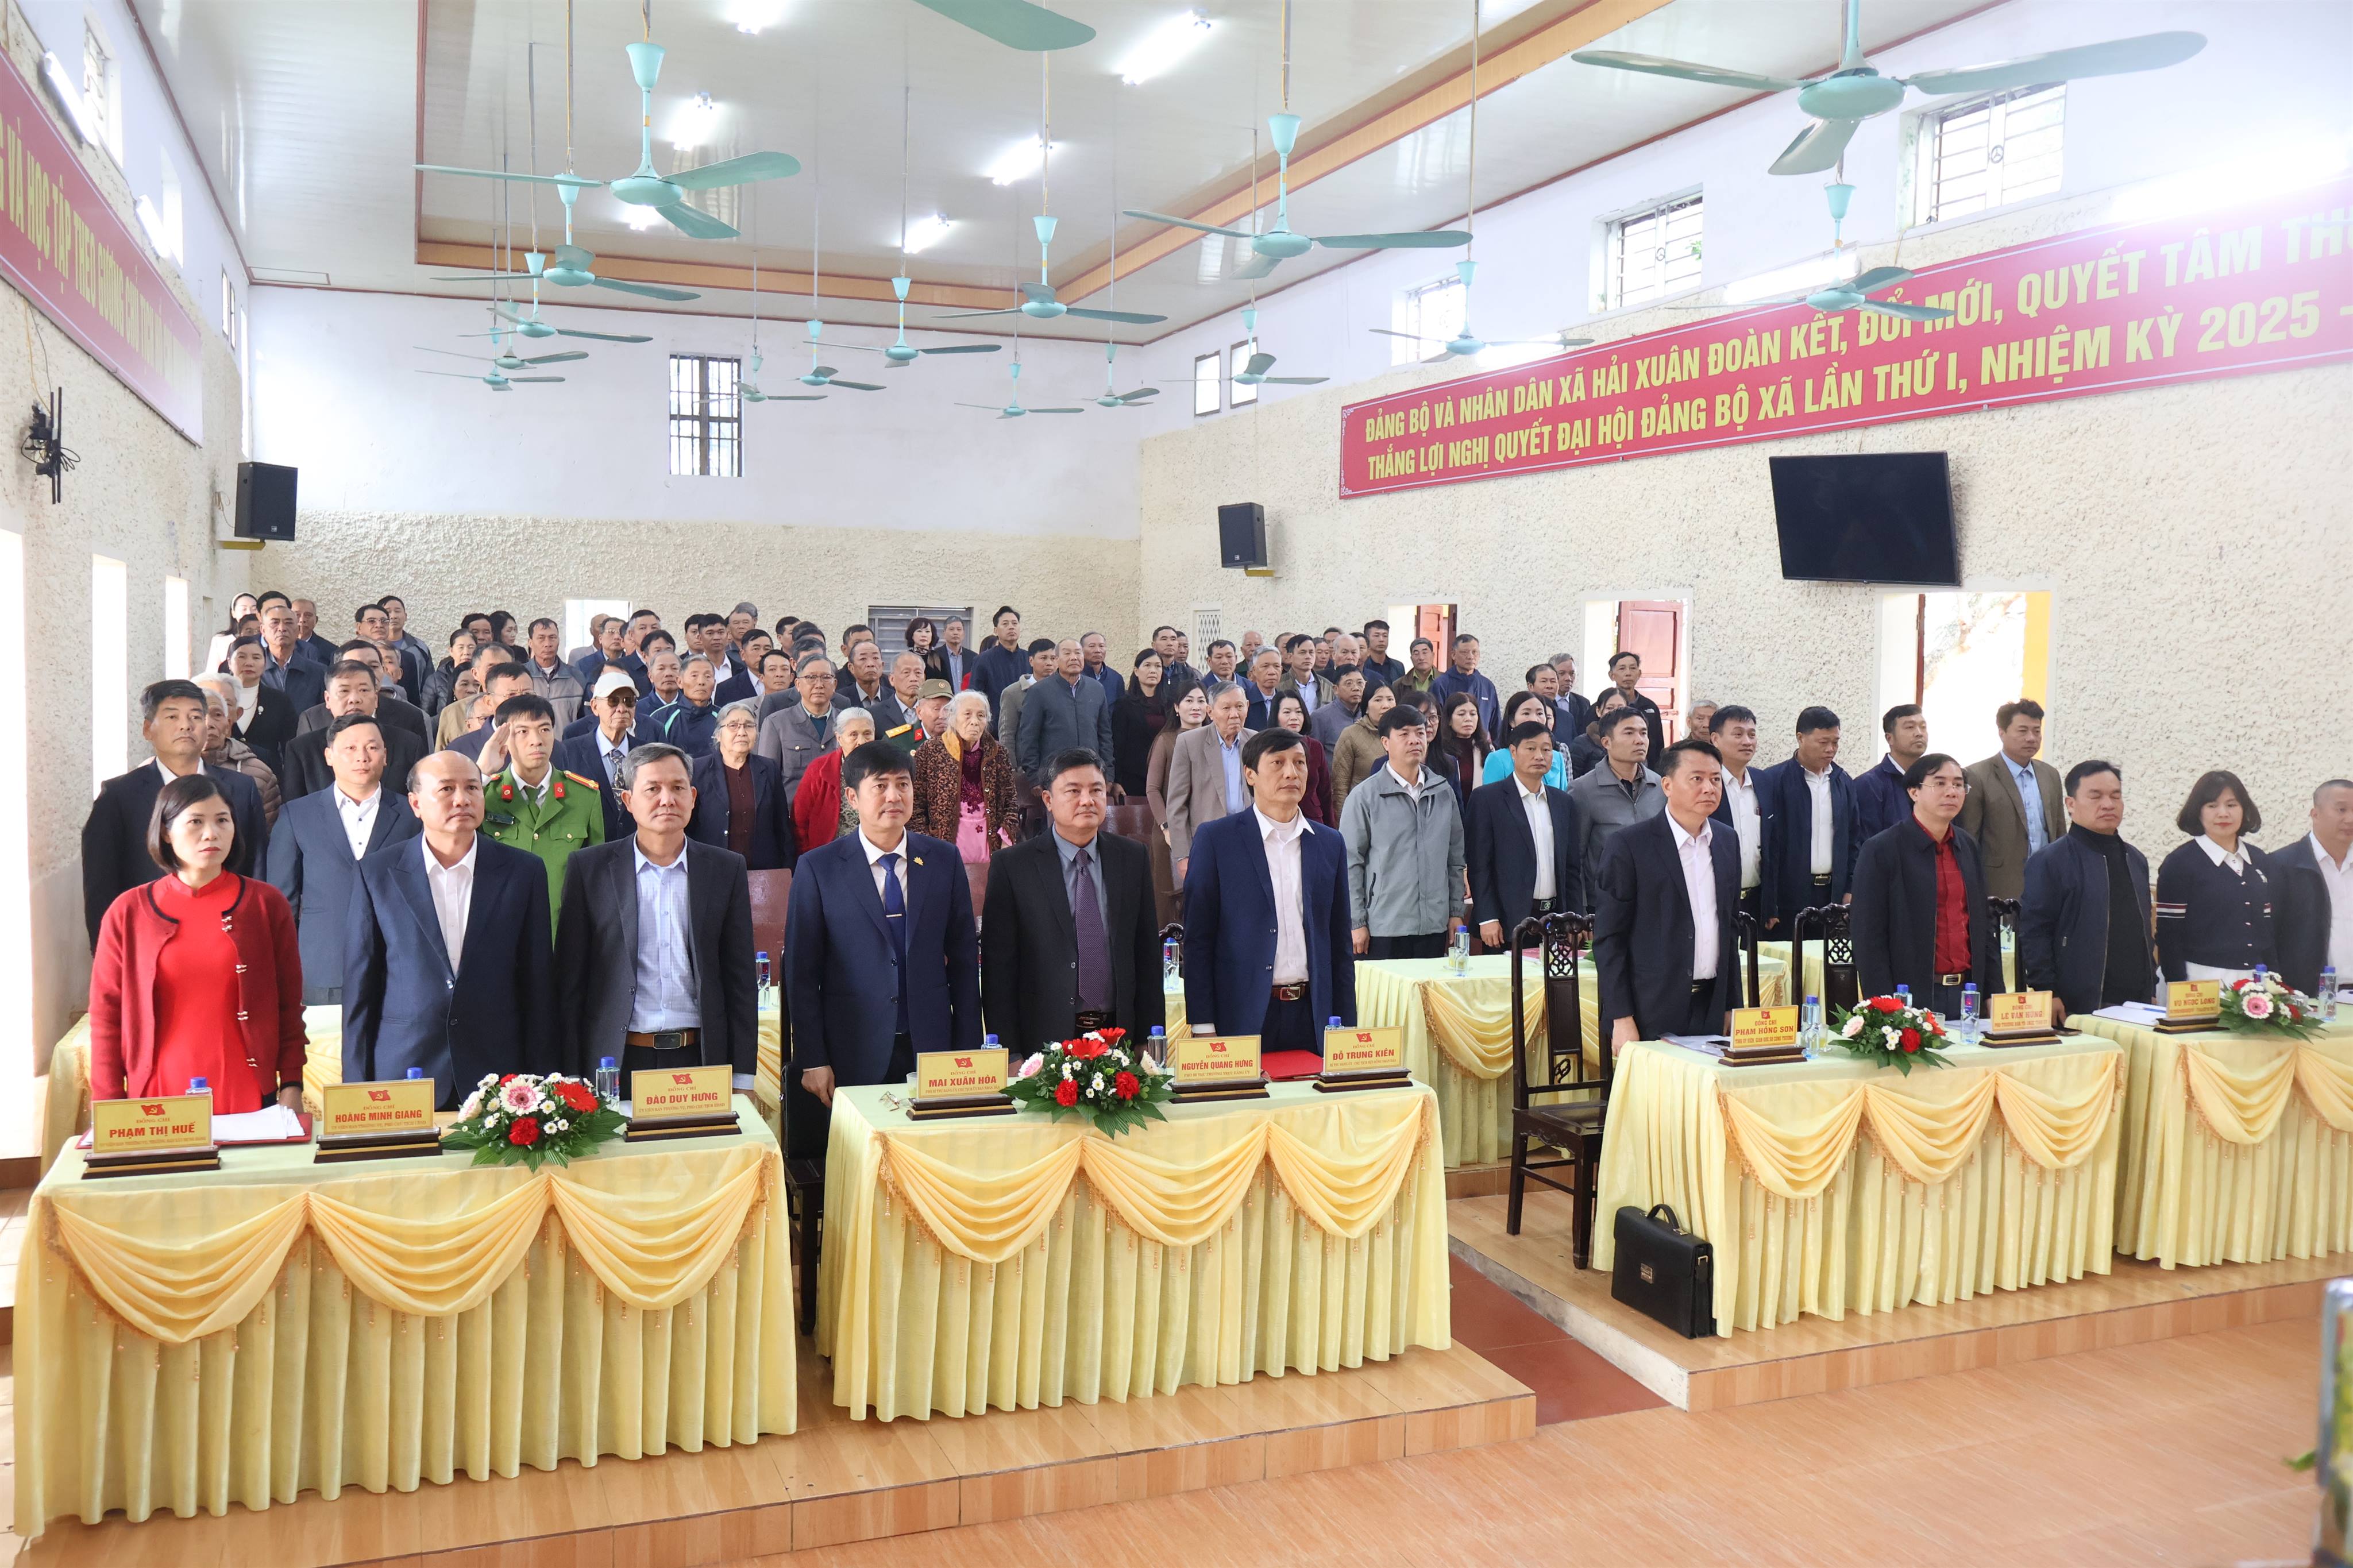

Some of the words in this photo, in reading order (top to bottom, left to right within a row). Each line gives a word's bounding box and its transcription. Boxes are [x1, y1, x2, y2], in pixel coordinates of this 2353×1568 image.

[7, 117, 24, 233] VÀ
[28, 150, 49, 271] HỌC
[52, 175, 71, 293] TẬP
[74, 211, 96, 308] THEO
[1365, 408, 1405, 442] ĐẢNG
[1409, 401, 1429, 437] BỘ
[1434, 396, 1455, 428] VÀ
[1460, 387, 1508, 424] NHÂN
[1514, 378, 1552, 414] DÂN
[1559, 366, 1586, 404] XÃ
[1592, 355, 1628, 398] HẢI
[1635, 345, 1700, 390] XUÂN
[1707, 329, 1781, 376] ĐOÀN
[1858, 288, 1912, 346] ĐỔI
[1924, 277, 2003, 334] MỚI,
[2018, 240, 2147, 318] QUYẾT
[2160, 227, 2263, 287] TÂM
[1368, 443, 1415, 480] THẮNG
[1420, 442, 1444, 476] LỢI
[1449, 437, 1490, 468] NGHỊ
[1494, 417, 1552, 463] QUYẾT
[1557, 418, 1591, 455] ĐẠI
[1598, 405, 1634, 449] HỘI
[1641, 393, 1707, 438] ĐẢNG
[1715, 383, 1749, 431] BỘ
[1757, 375, 1795, 421] XÃ
[1804, 362, 1863, 413] LẦN
[1873, 349, 1939, 402] THỨ
[1947, 352, 1968, 394] I,
[1981, 325, 2111, 385] NHIỆM
[2126, 306, 2184, 364] KỲ
[2197, 290, 2320, 353] 2025
[1347, 1051, 1373, 1059] TRUNG
[1376, 1048, 1394, 1057] KIÊN
[1182, 1060, 1209, 1071] NGUYỄN
[1210, 1061, 1233, 1069] QUANG
[1235, 1059, 1253, 1067] HƯNG
[929, 1079, 947, 1087] MAI
[950, 1076, 975, 1086] XUÂN
[978, 1075, 997, 1084] HÒA
[646, 1094, 666, 1105] ĐÀO
[669, 1094, 688, 1103] DUY
[692, 1092, 718, 1102] HƯNG
[335, 1112, 366, 1123] HOÀNG
[369, 1111, 392, 1121] MINH
[395, 1110, 422, 1119] GIANG
[109, 1127, 145, 1139] PHẠM
[149, 1126, 168, 1137] THỊ
[172, 1121, 196, 1134] HUẾ
